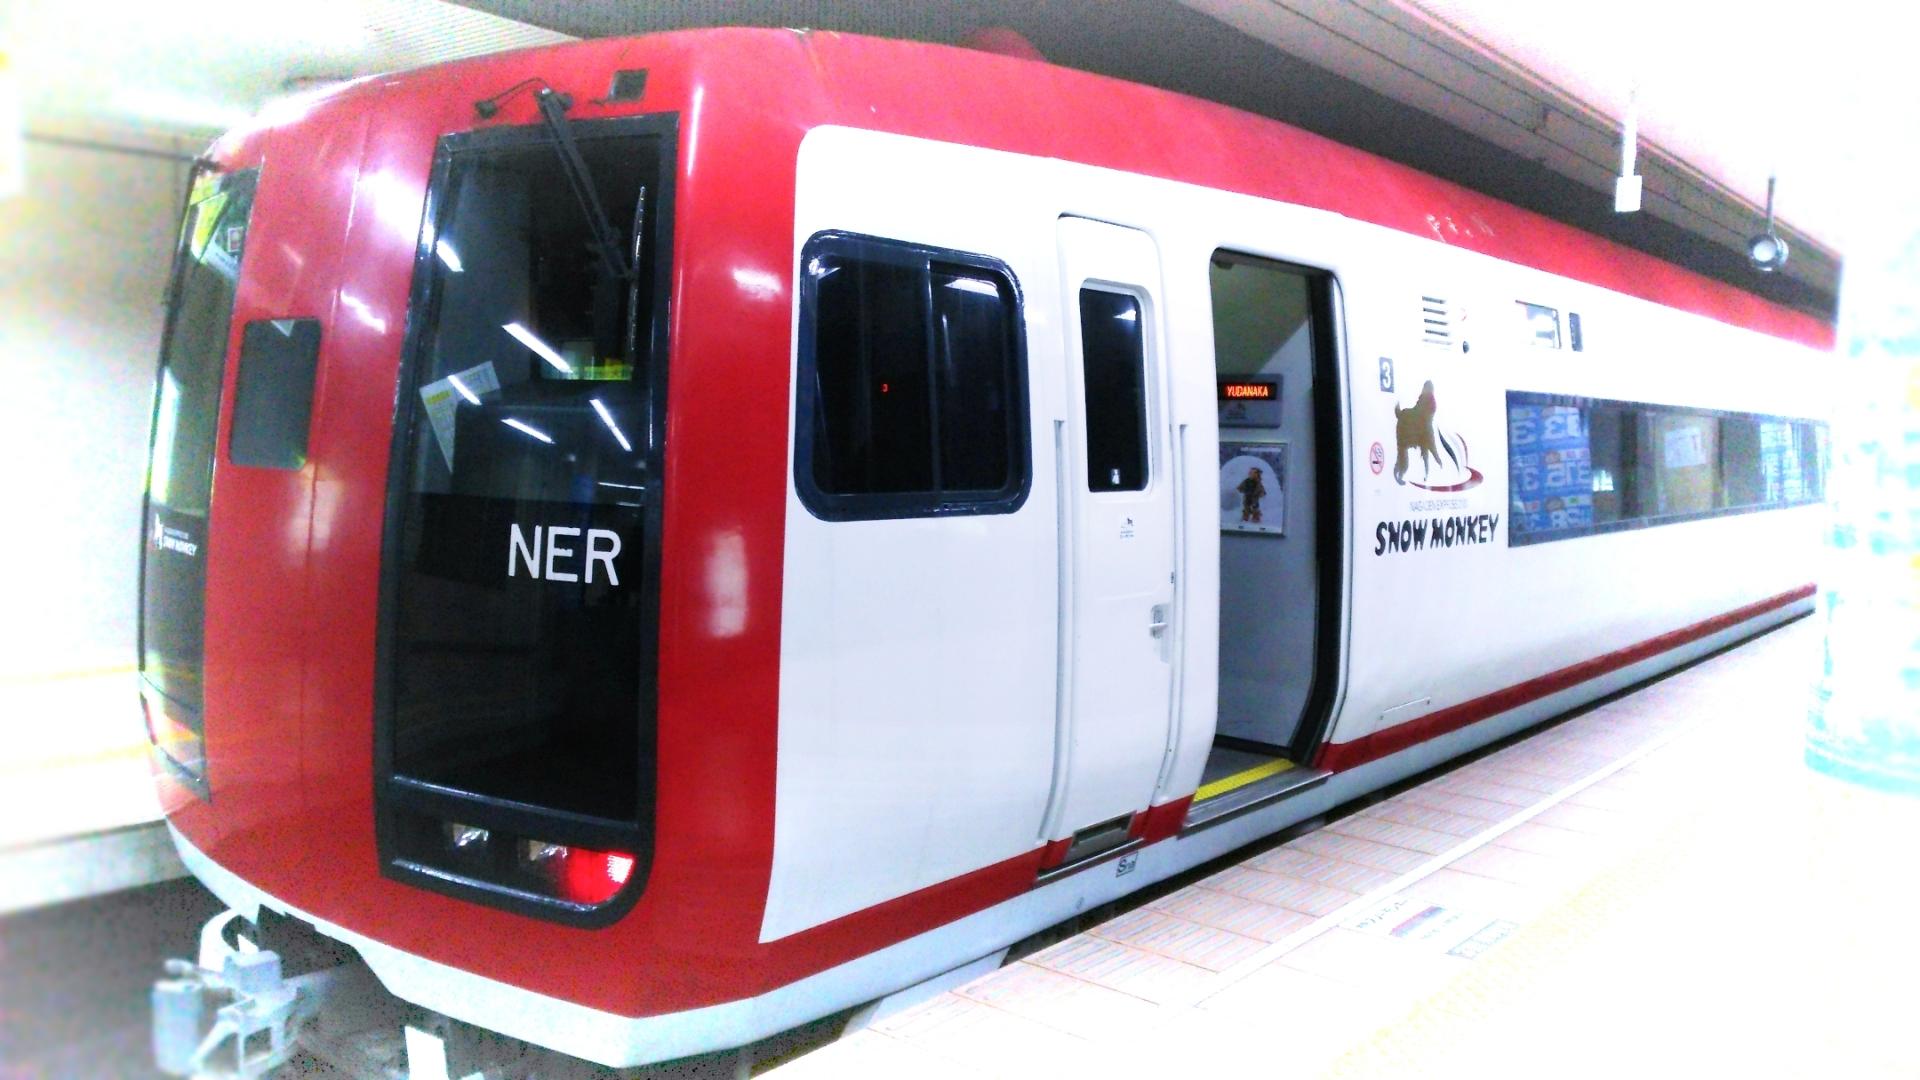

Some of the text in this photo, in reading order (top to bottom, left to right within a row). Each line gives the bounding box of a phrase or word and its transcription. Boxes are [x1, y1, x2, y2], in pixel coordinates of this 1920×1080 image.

[1226, 385, 1269, 397] YUDANAKA
[1382, 361, 1392, 389] 3
[1374, 513, 1500, 557] SNOW MONKEY
[508, 523, 622, 586] NER
